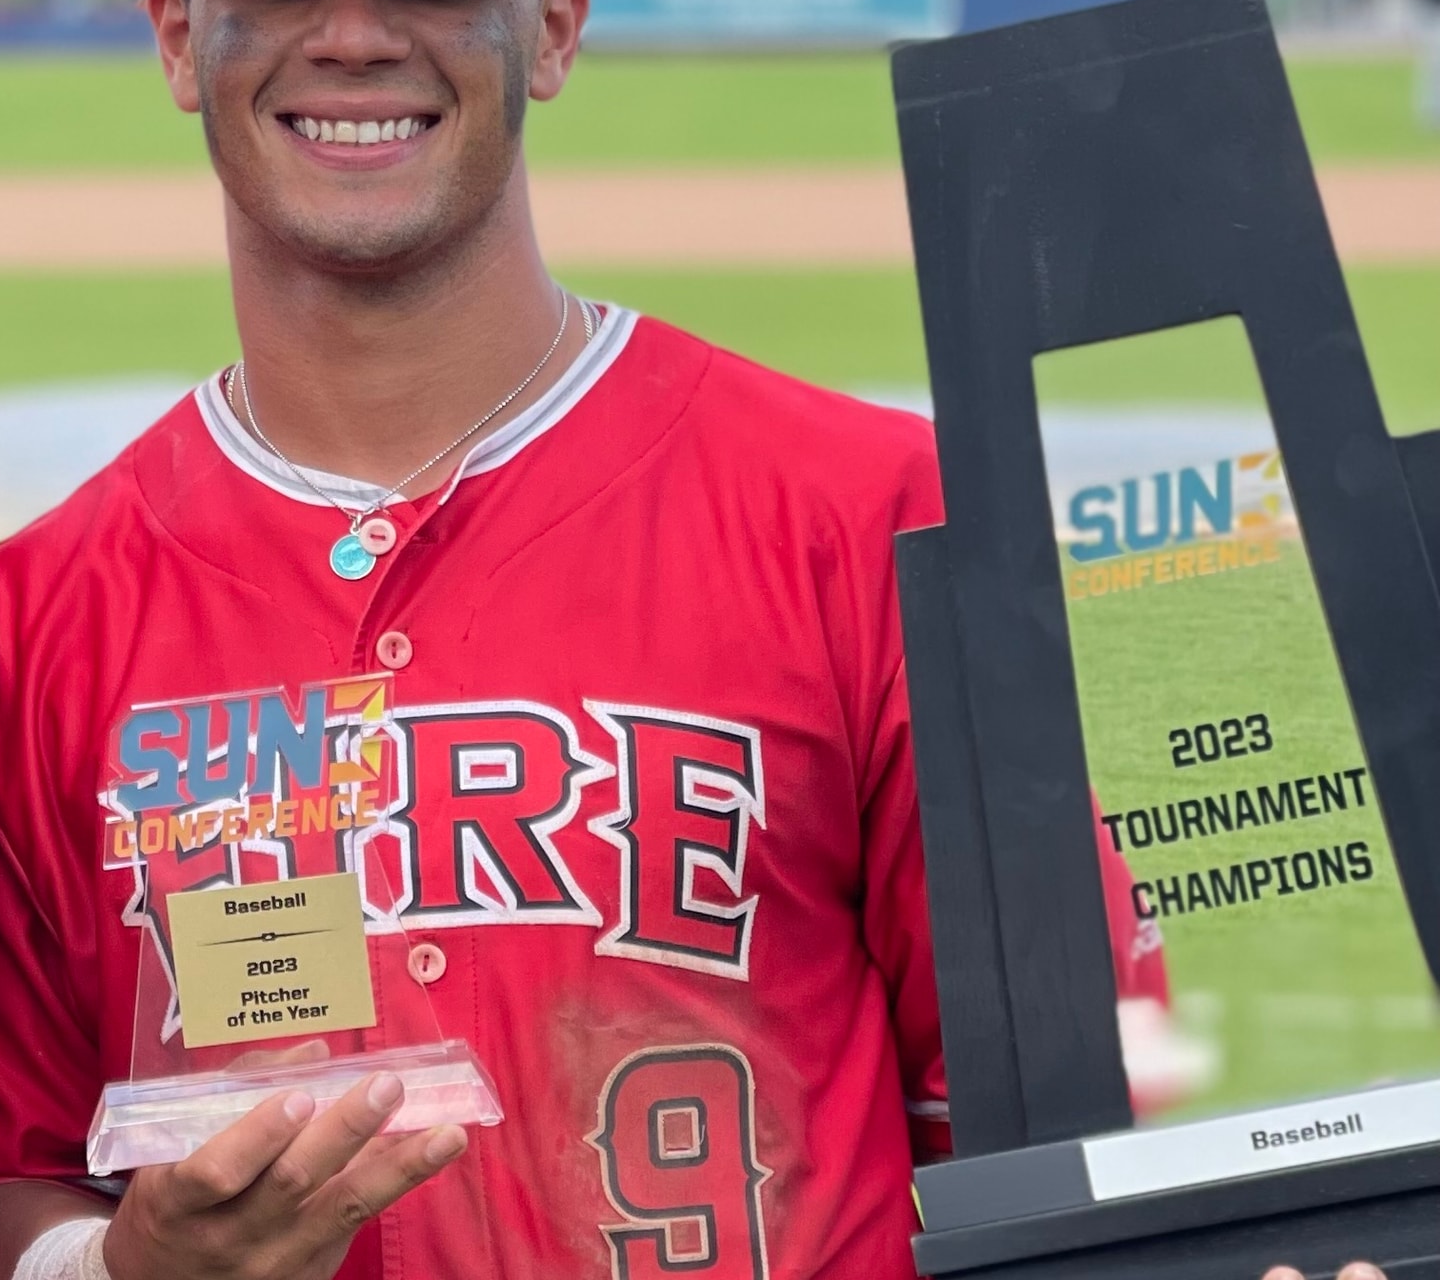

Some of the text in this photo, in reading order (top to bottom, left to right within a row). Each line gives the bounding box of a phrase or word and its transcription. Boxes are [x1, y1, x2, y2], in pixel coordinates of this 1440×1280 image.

[1068, 457, 1233, 563] SUN
[1068, 532, 1282, 601] CONFERENCE
[116, 688, 327, 812] SUN
[1168, 712, 1274, 769] 2023
[113, 789, 380, 858] CONFERENCE
[1100, 766, 1367, 853] TOURNAMENT
[223, 892, 307, 916] Baseball
[1130, 840, 1374, 921] CHAMPIONS
[240, 986, 311, 1007] Pitcher
[246, 956, 299, 977] 2023
[227, 1003, 329, 1028] of the Year
[1250, 1112, 1366, 1151] Baseball
